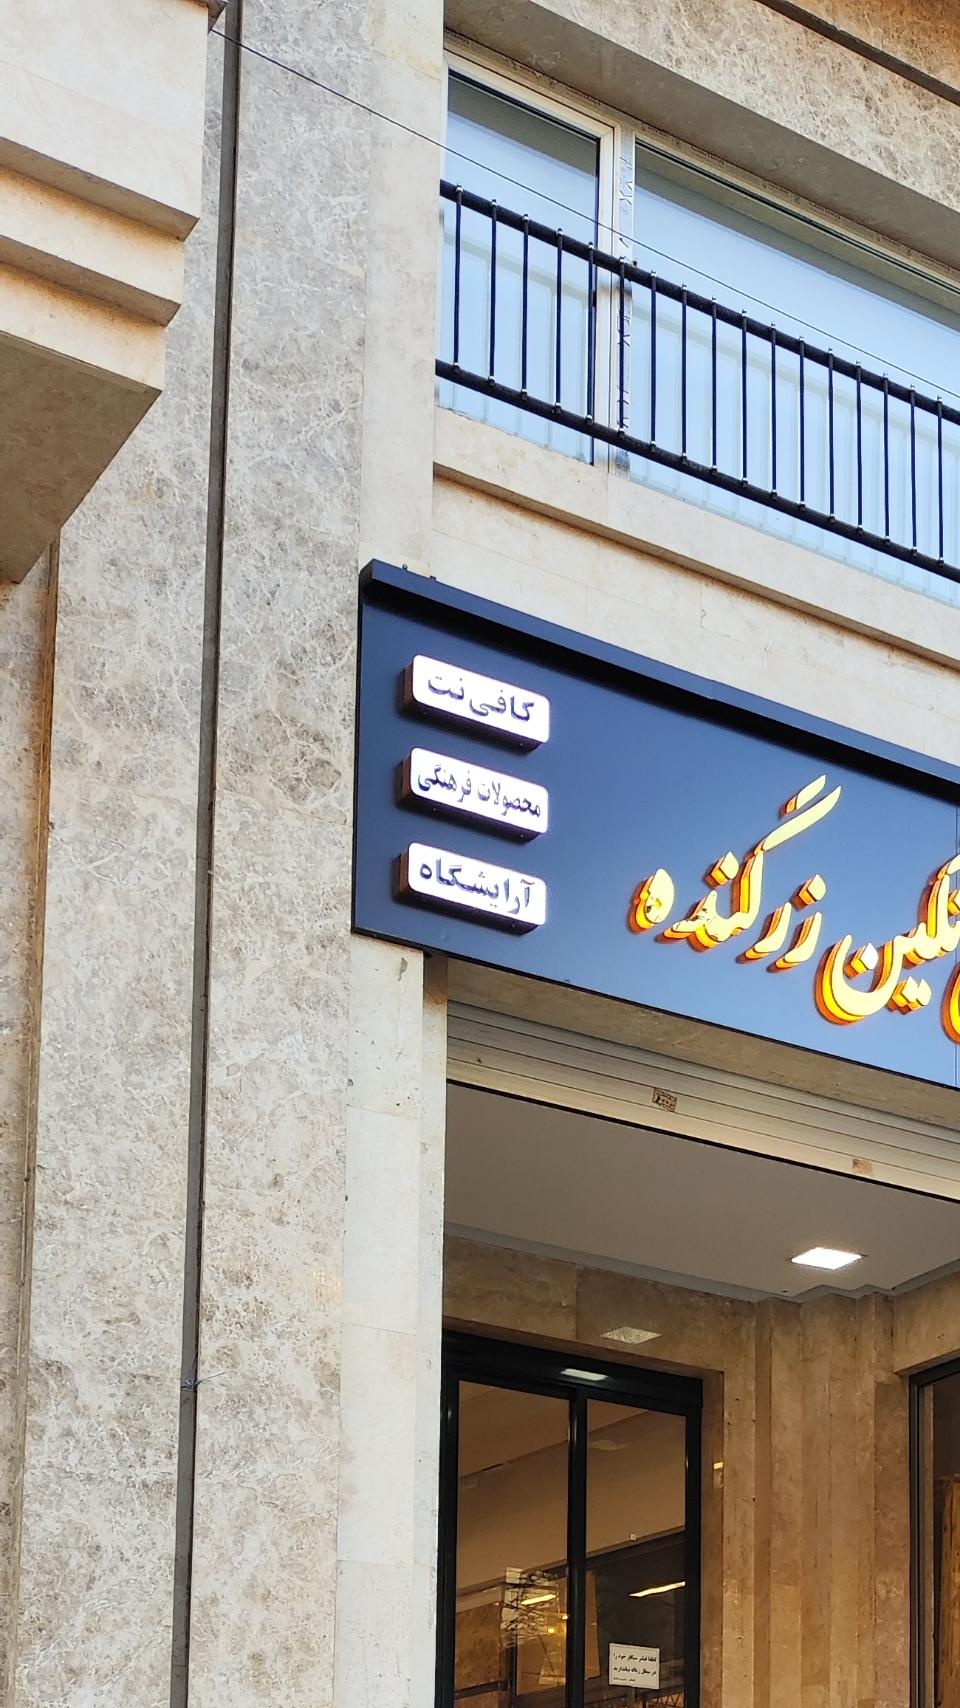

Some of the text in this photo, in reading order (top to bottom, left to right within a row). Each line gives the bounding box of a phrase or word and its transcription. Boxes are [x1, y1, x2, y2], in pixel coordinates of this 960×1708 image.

[417, 763, 541, 818] محصولات فرهنگی
[419, 857, 536, 915] آرایشگاه
